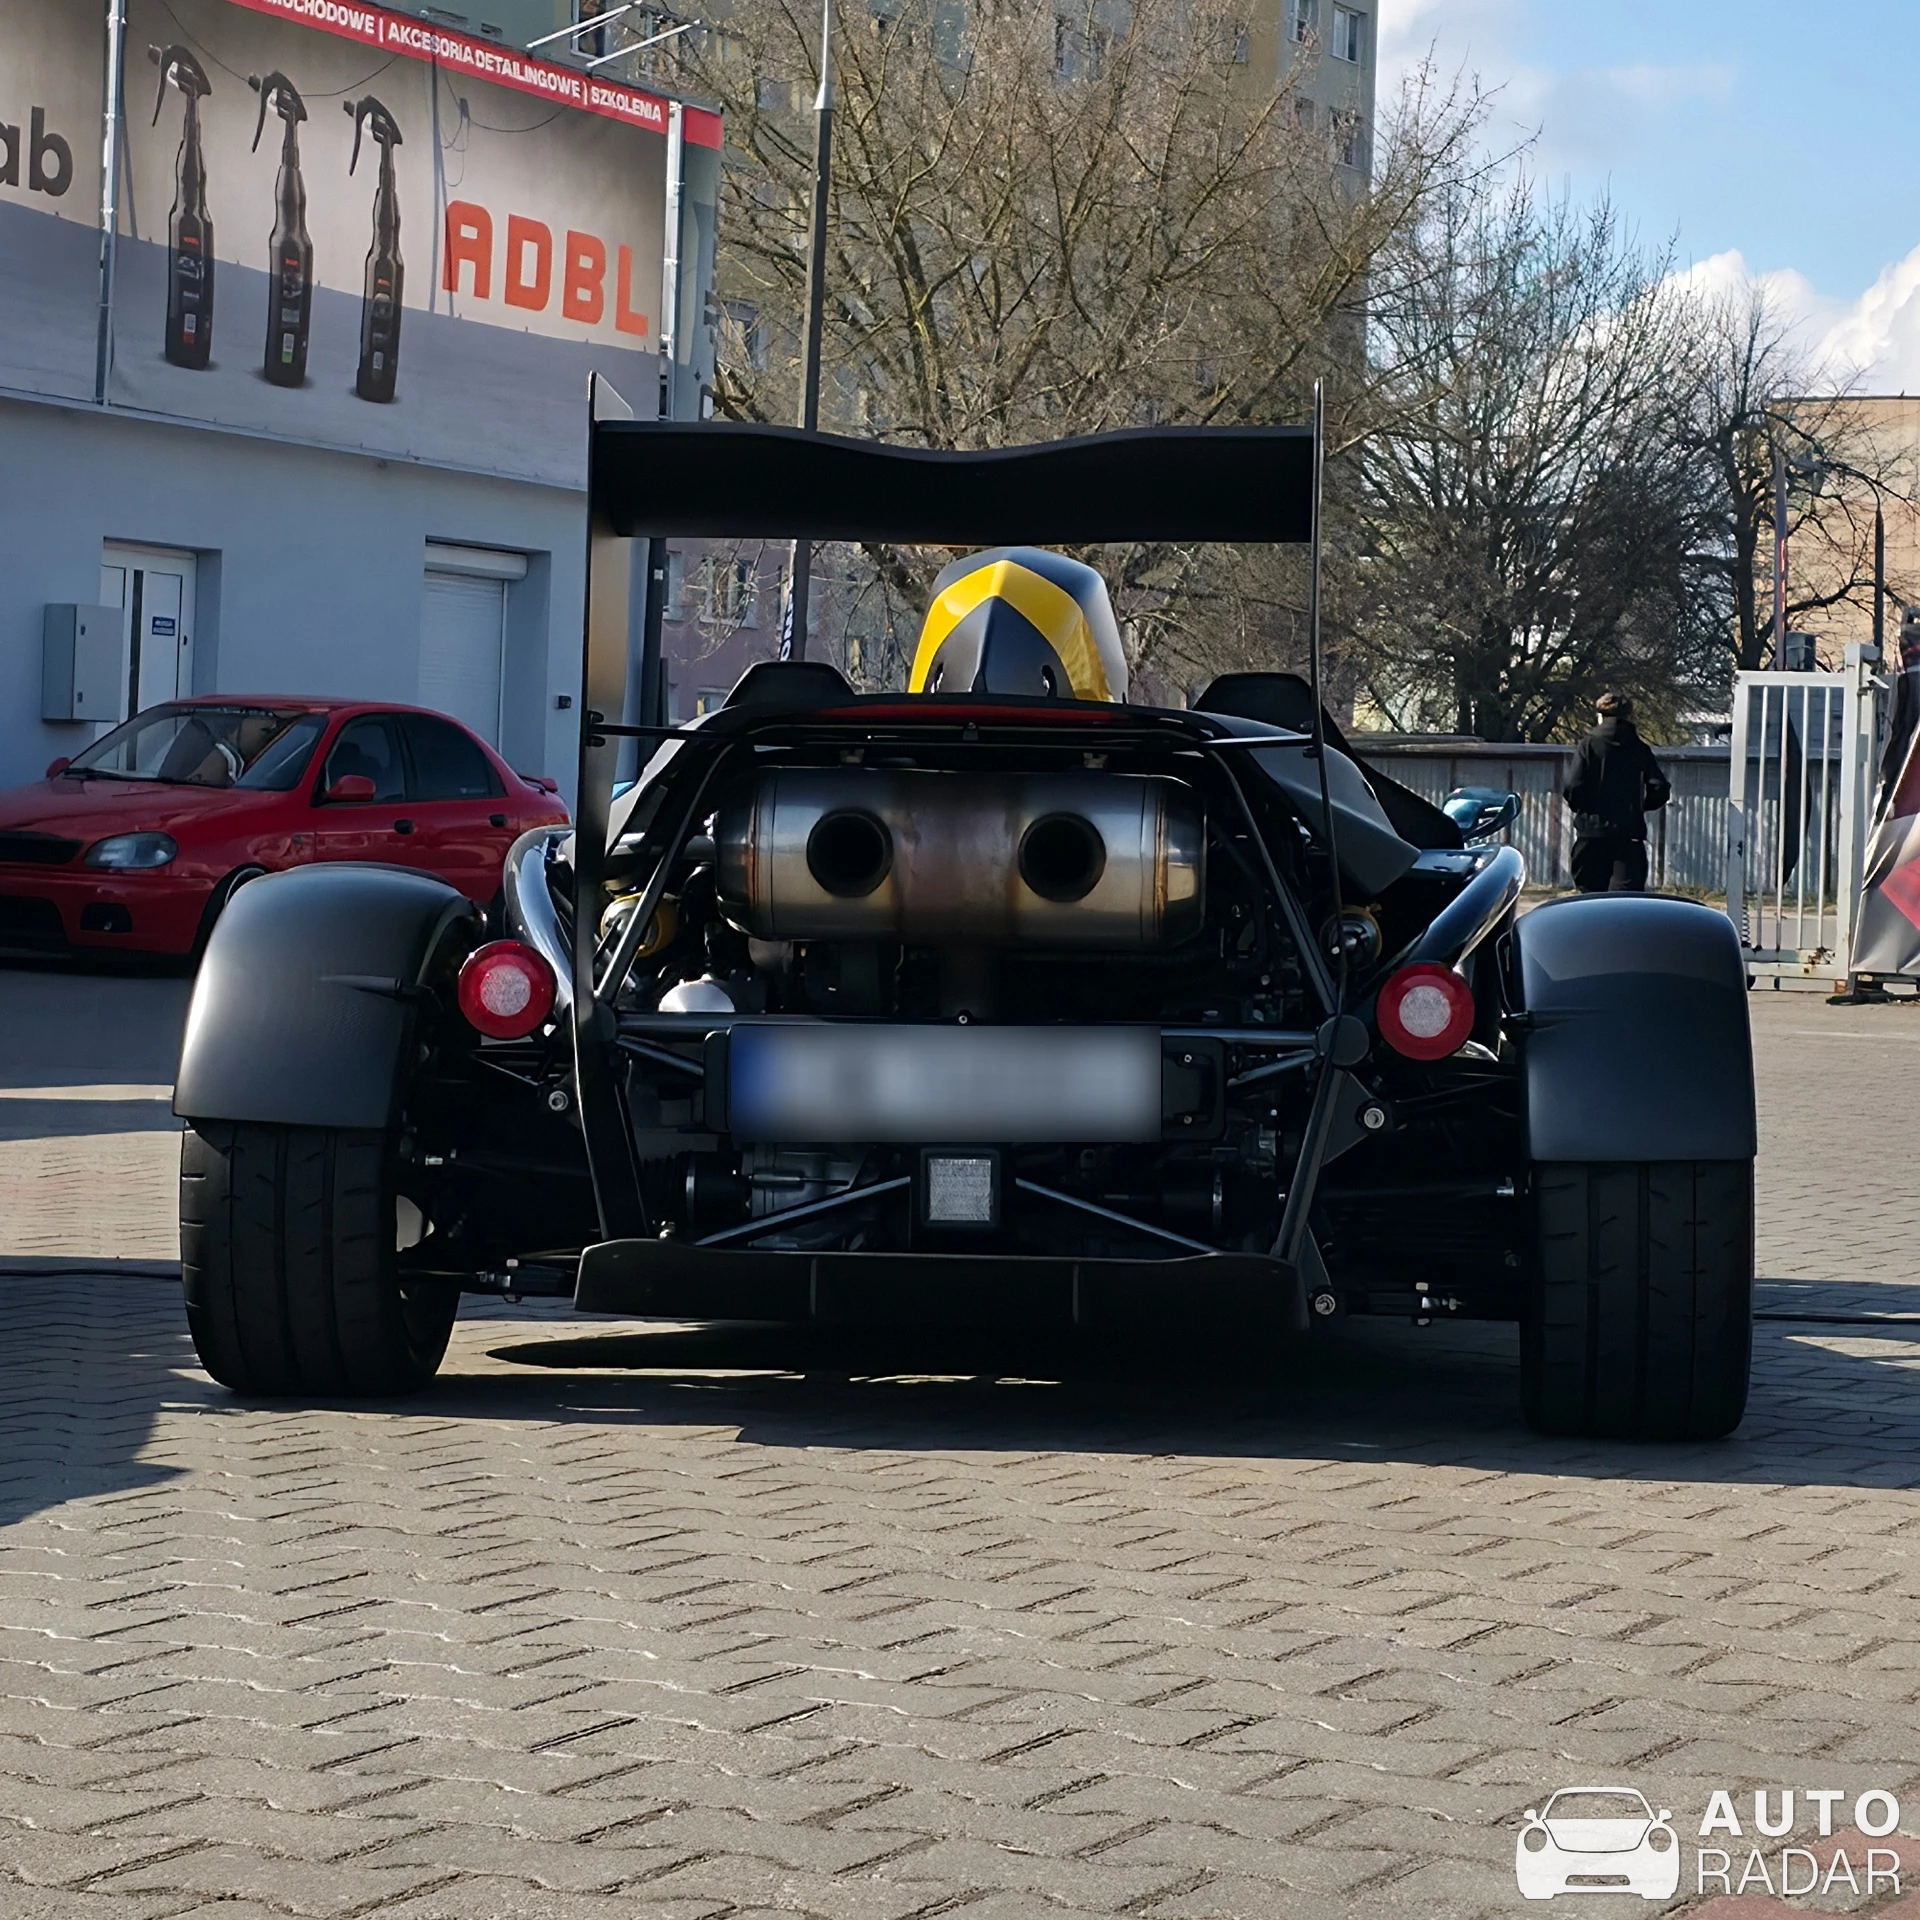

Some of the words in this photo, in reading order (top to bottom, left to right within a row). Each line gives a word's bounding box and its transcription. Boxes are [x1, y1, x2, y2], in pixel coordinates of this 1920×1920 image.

[388, 22, 476, 63] AKCESORIA
[474, 49, 580, 99] DETAILINGOWE
[591, 86, 662, 122] SZKOLENIA
[442, 200, 648, 336] ADBL
